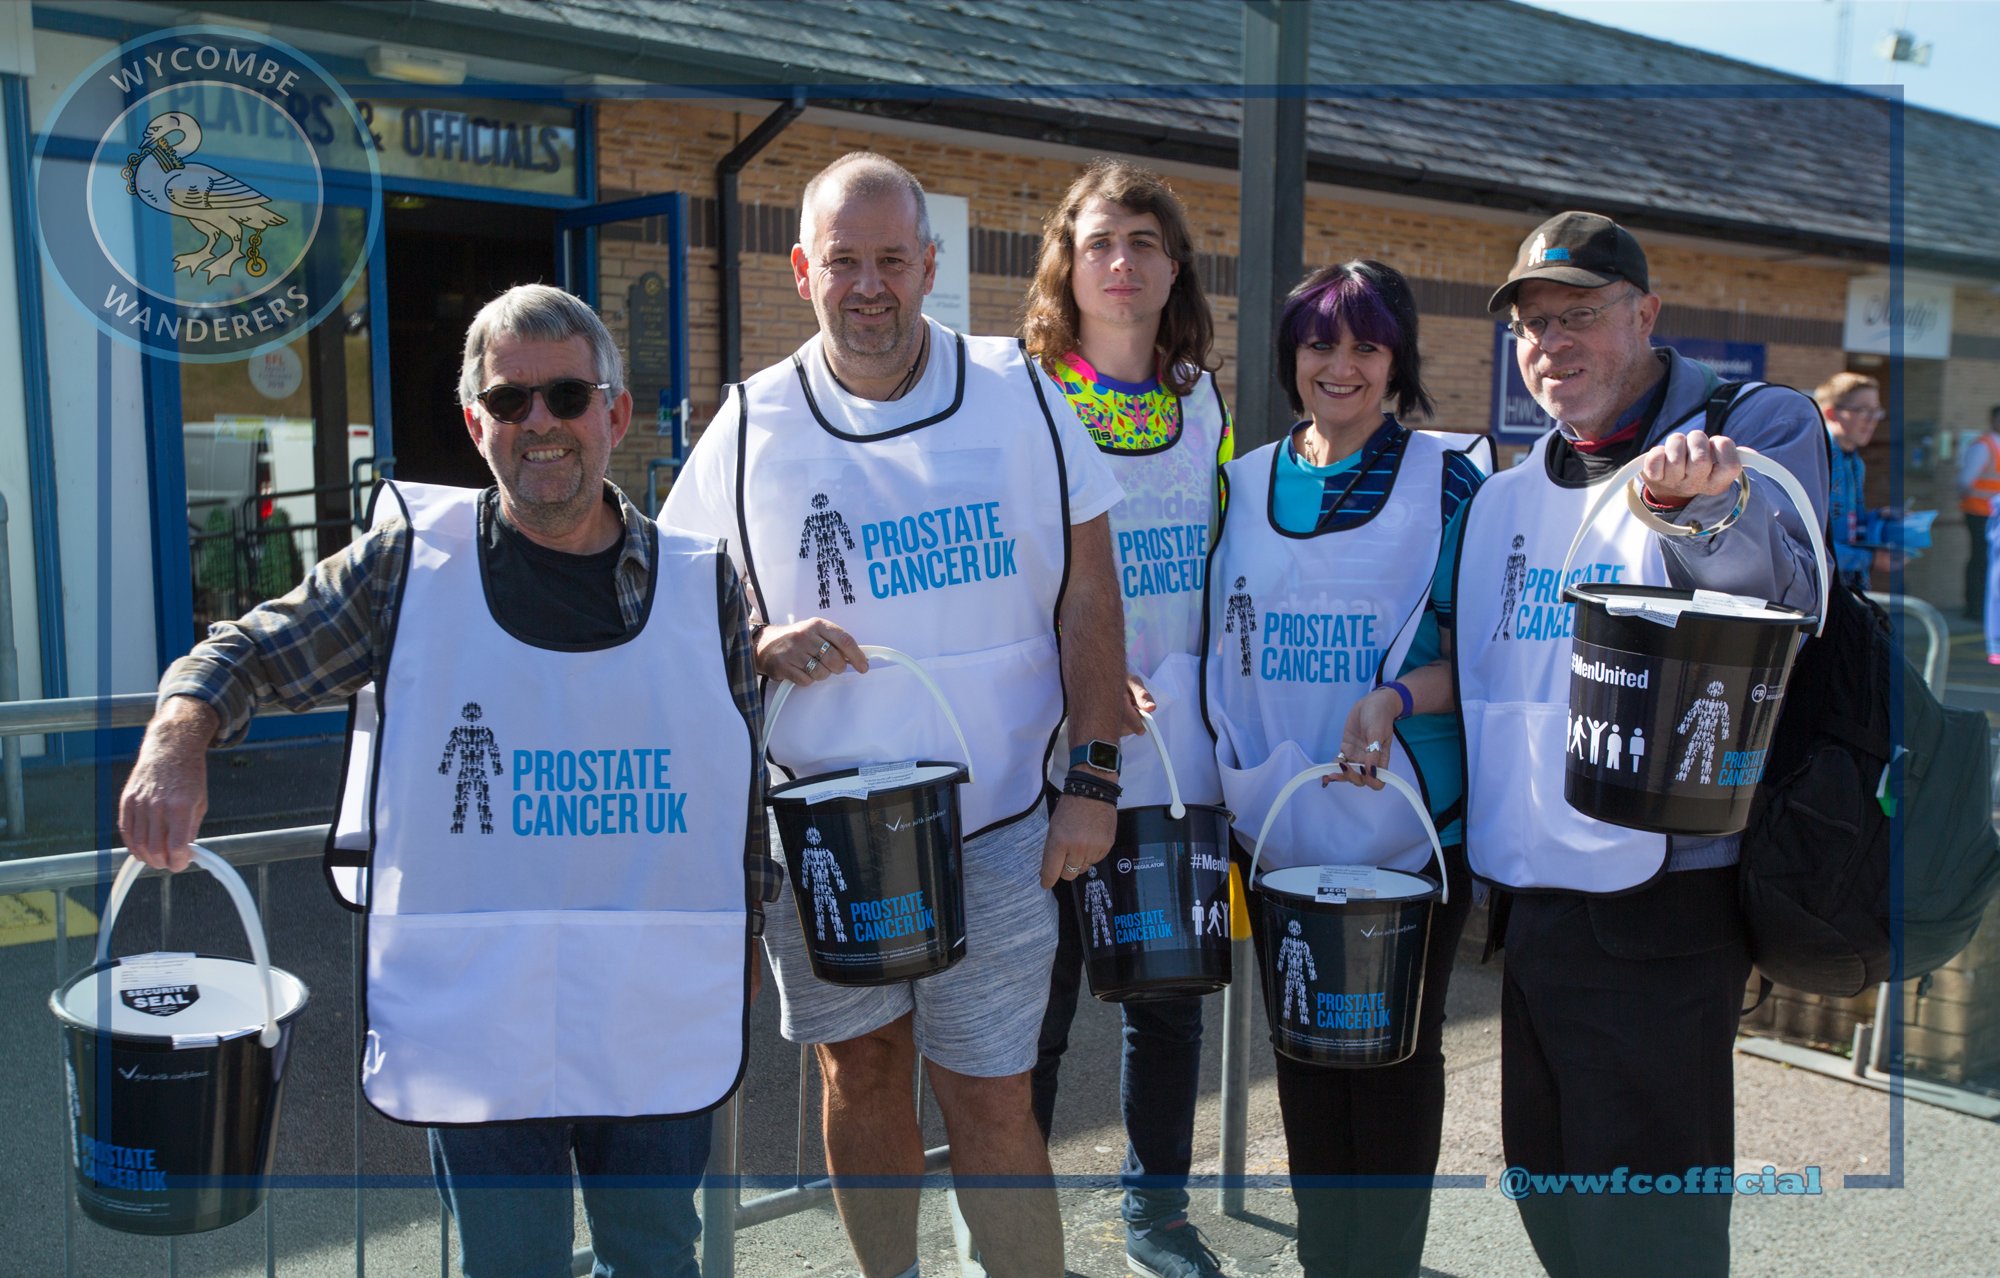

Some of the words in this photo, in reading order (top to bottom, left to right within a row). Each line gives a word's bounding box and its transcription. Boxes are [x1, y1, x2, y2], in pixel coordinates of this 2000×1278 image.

[402, 107, 562, 174] OFFICIALS
[861, 501, 1004, 560] PROSTATE
[868, 544, 982, 599] CANCER
[983, 538, 1018, 579] UK
[1263, 612, 1377, 648] PROSTATE
[1261, 647, 1350, 684] CANCER
[1571, 652, 1650, 690] #MenUnited
[512, 747, 672, 792] PROSTATE
[1721, 748, 1768, 769] PROSTAT
[511, 792, 640, 837] CANCER
[645, 792, 688, 834] UK
[849, 890, 926, 922] PROSTATE
[1114, 910, 1164, 930] PROSTATE
[853, 915, 916, 943] CANCER
[915, 908, 935, 932] UK
[1116, 925, 1157, 944] CANCER
[1157, 923, 1173, 938] UK
[127, 985, 190, 998] SECURITY
[133, 994, 190, 1008] SEAL
[1317, 992, 1385, 1012] PROSTATE
[1317, 1009, 1372, 1030] CANCER
[1373, 1008, 1391, 1028] UK
[141, 1169, 168, 1191] UK
